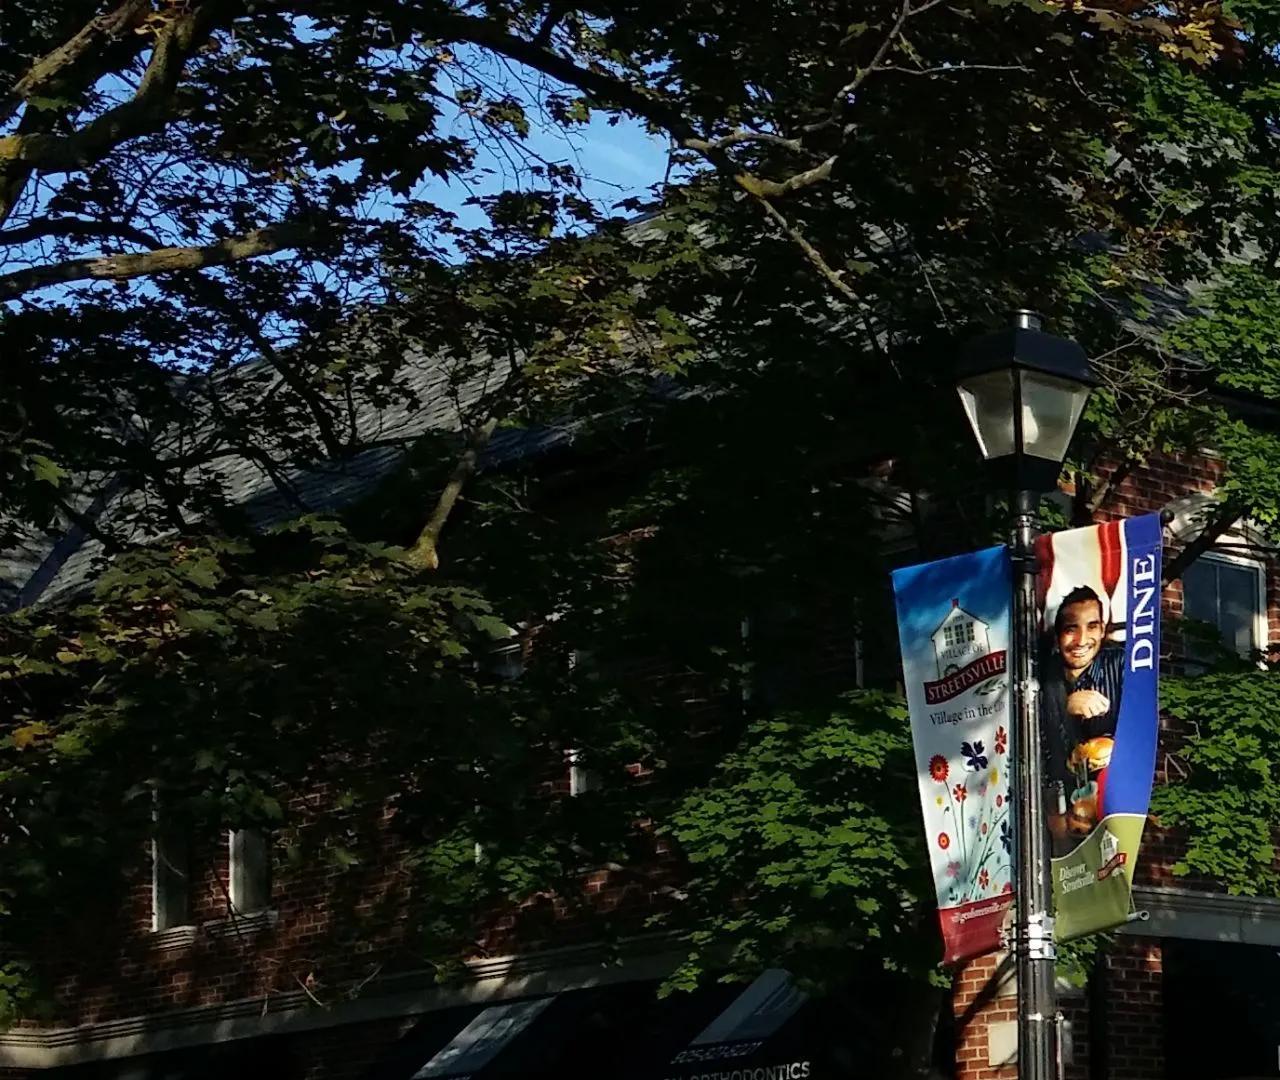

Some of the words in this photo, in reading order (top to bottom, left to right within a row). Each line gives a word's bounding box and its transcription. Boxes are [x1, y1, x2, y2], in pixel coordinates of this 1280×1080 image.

[1131, 554, 1155, 672] DINE
[928, 655, 1005, 700] STREETSVILLE
[929, 710, 963, 726] Village
[964, 707, 976, 718] in
[978, 704, 993, 716] the
